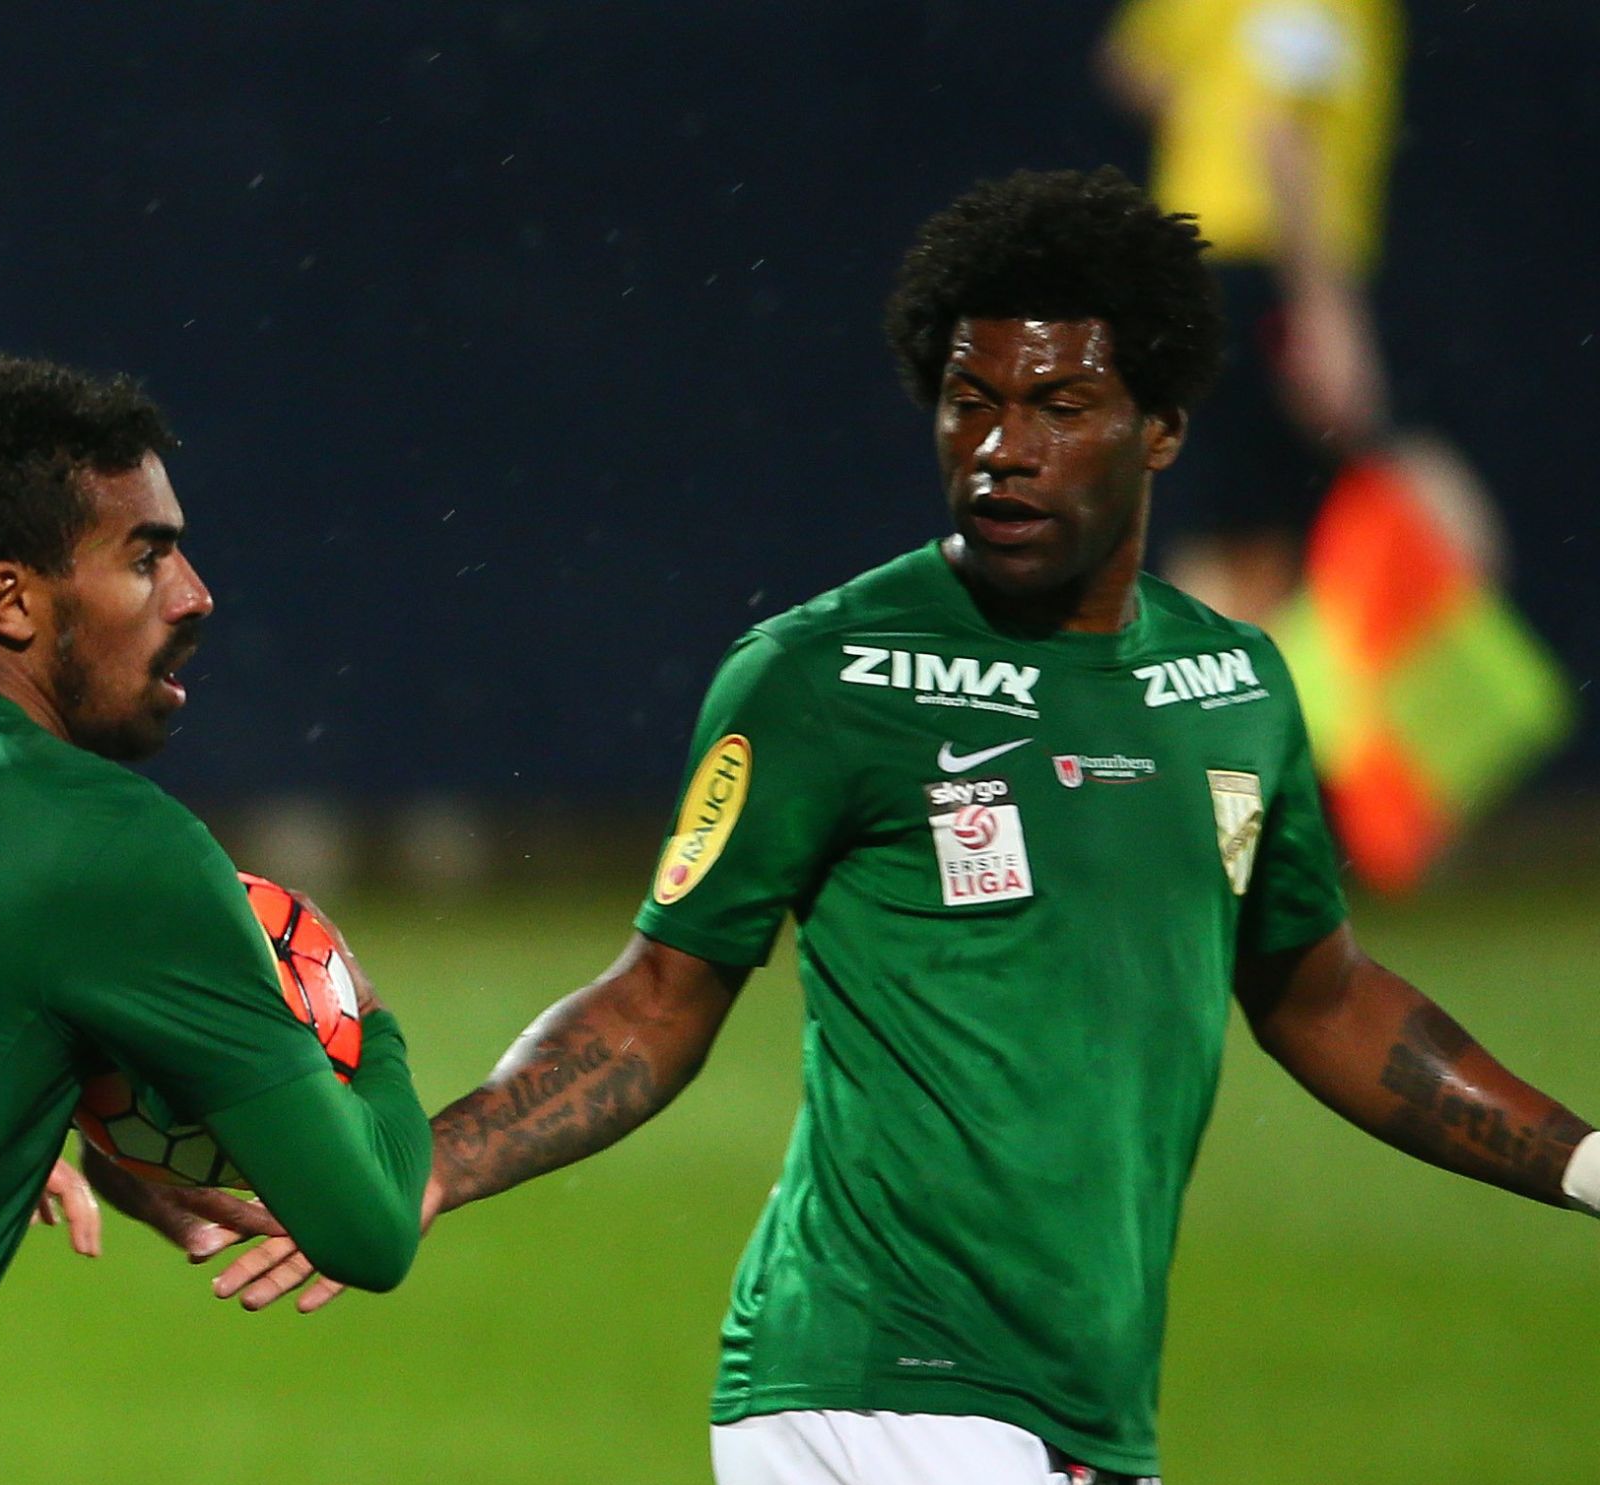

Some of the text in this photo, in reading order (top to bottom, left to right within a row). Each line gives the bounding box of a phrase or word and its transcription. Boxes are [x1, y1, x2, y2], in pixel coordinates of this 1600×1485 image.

[681, 754, 743, 863] RAUCH
[946, 853, 1018, 877] ERSTE
[949, 868, 1024, 897] LIGA
